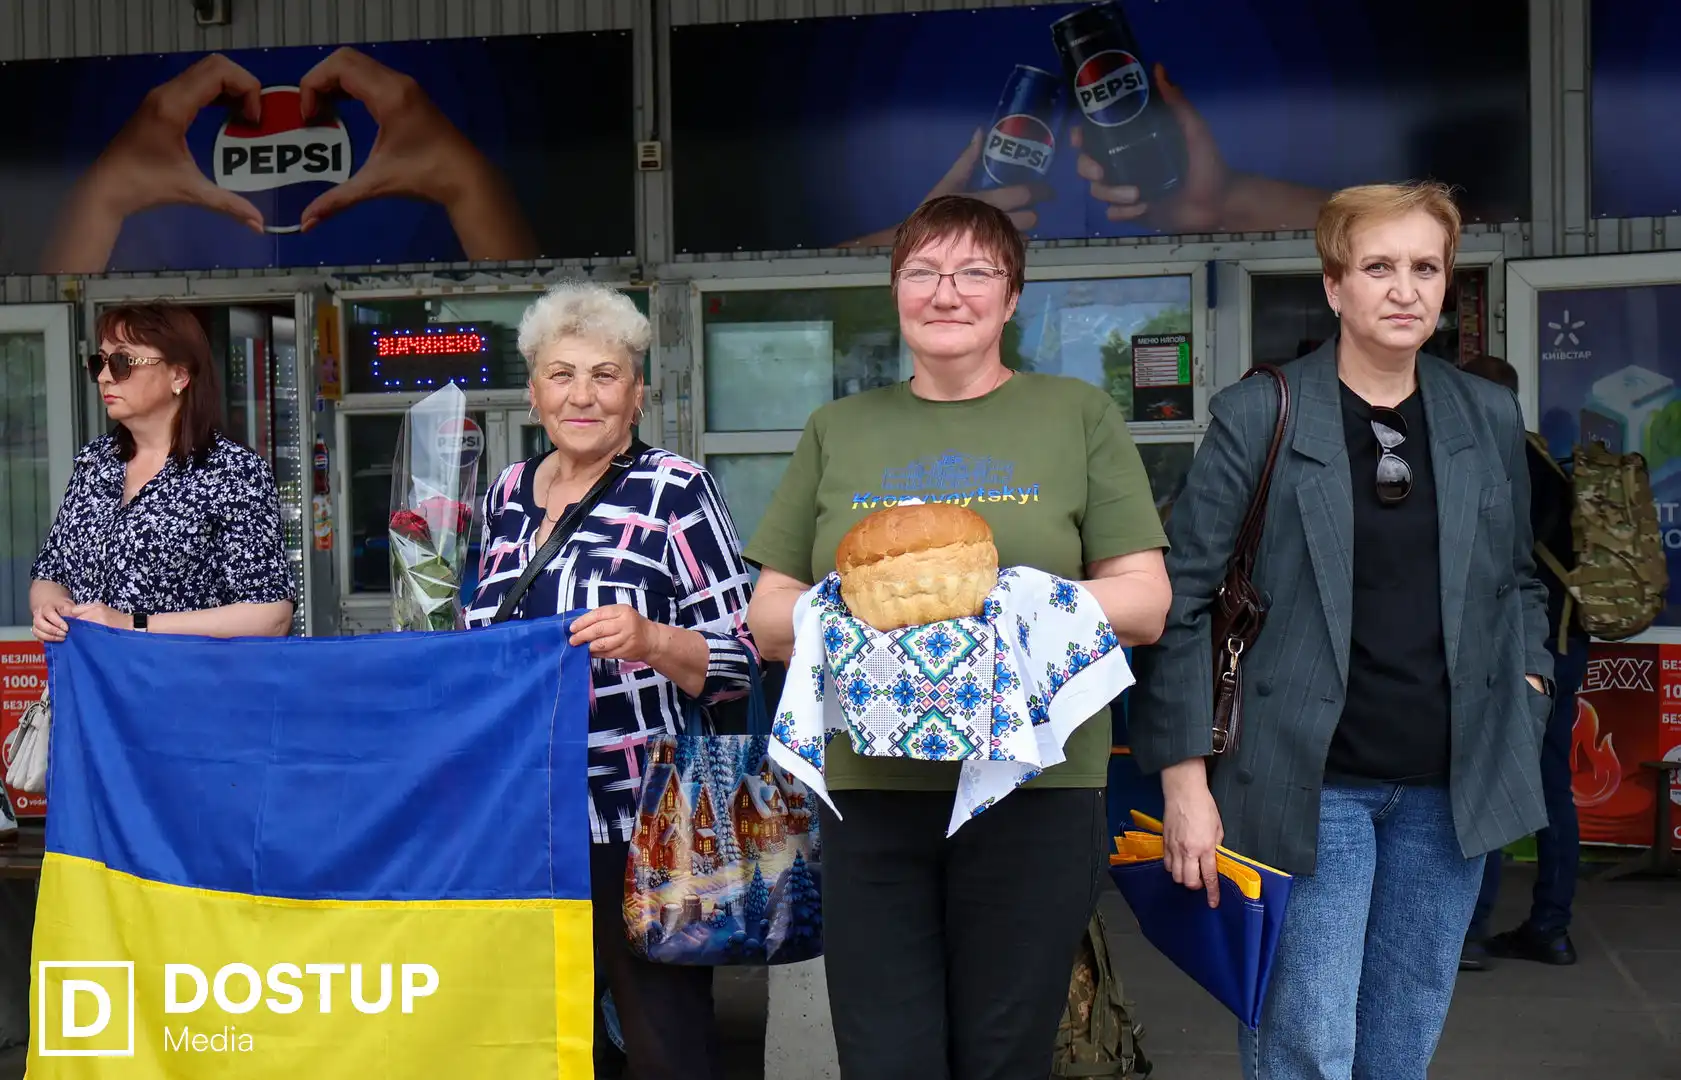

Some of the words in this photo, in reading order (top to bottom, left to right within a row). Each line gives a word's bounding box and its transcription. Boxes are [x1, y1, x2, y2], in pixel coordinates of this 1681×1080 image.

[1079, 71, 1144, 107] PEPSI
[222, 142, 342, 176] PEPSI
[988, 134, 1049, 169] PEPSI
[378, 334, 481, 356] ВІДЧИНЕНО
[1137, 337, 1159, 345] МЕНЮ
[1541, 348, 1592, 361] КИЇВСТАР
[437, 435, 480, 448] PEPSI
[1, 653, 46, 664] БЕЗЛІМІ
[3, 674, 39, 689] 1000
[1575, 658, 1655, 695] EXX
